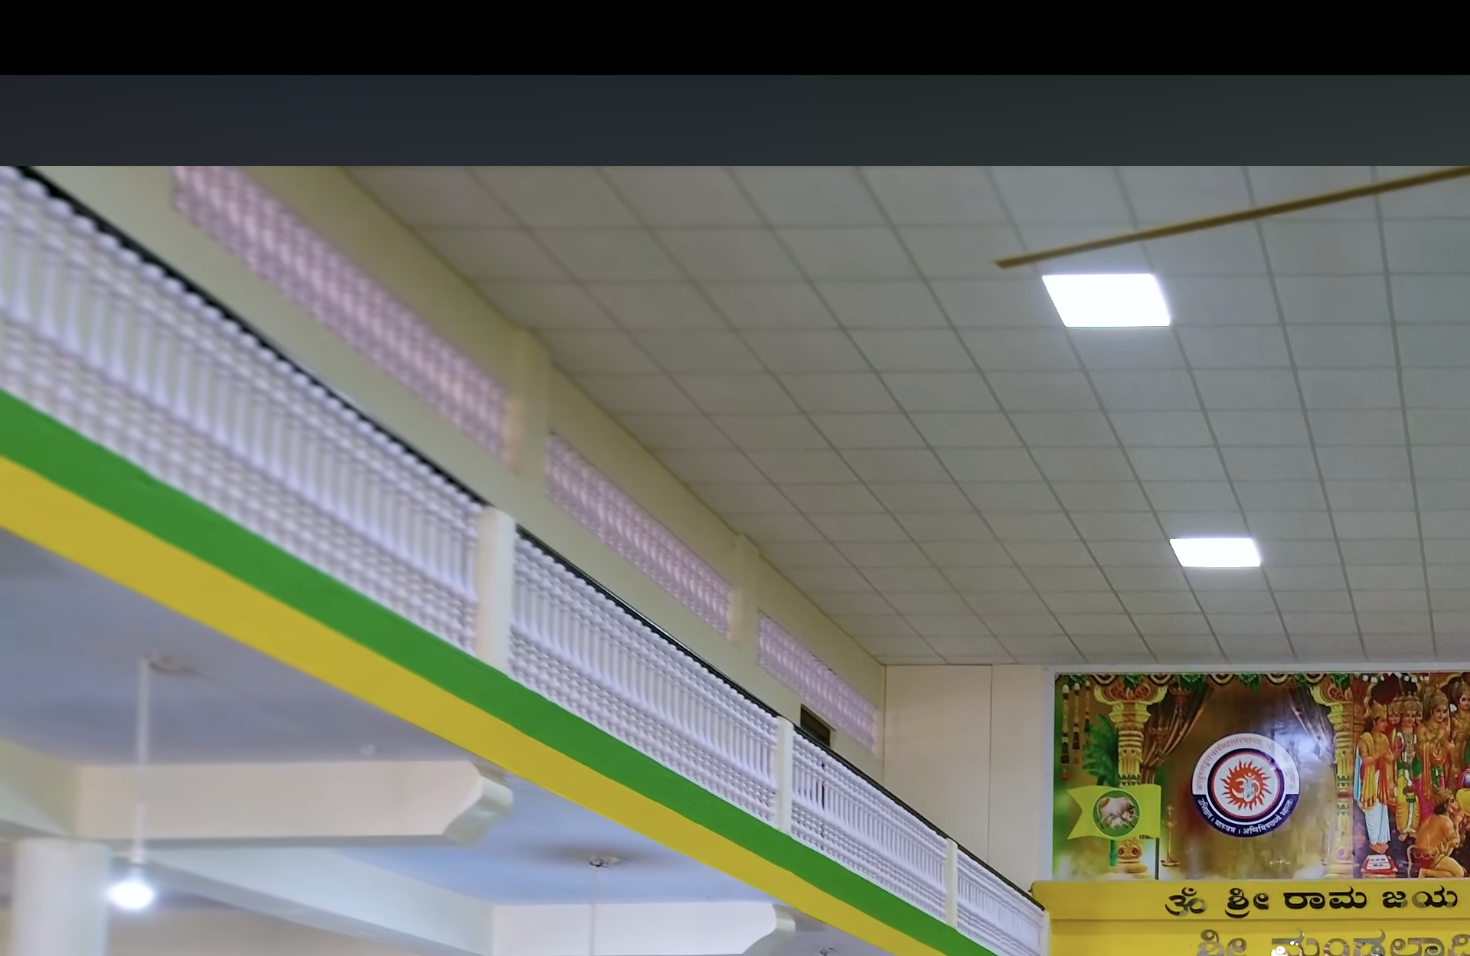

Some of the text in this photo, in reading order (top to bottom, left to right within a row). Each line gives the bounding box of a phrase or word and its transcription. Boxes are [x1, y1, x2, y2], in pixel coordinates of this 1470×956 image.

[1224, 887, 1270, 919] ಶ್ರೀ
[1283, 885, 1368, 909] ರಾಮ
[1382, 885, 1458, 909] ಜಯ
